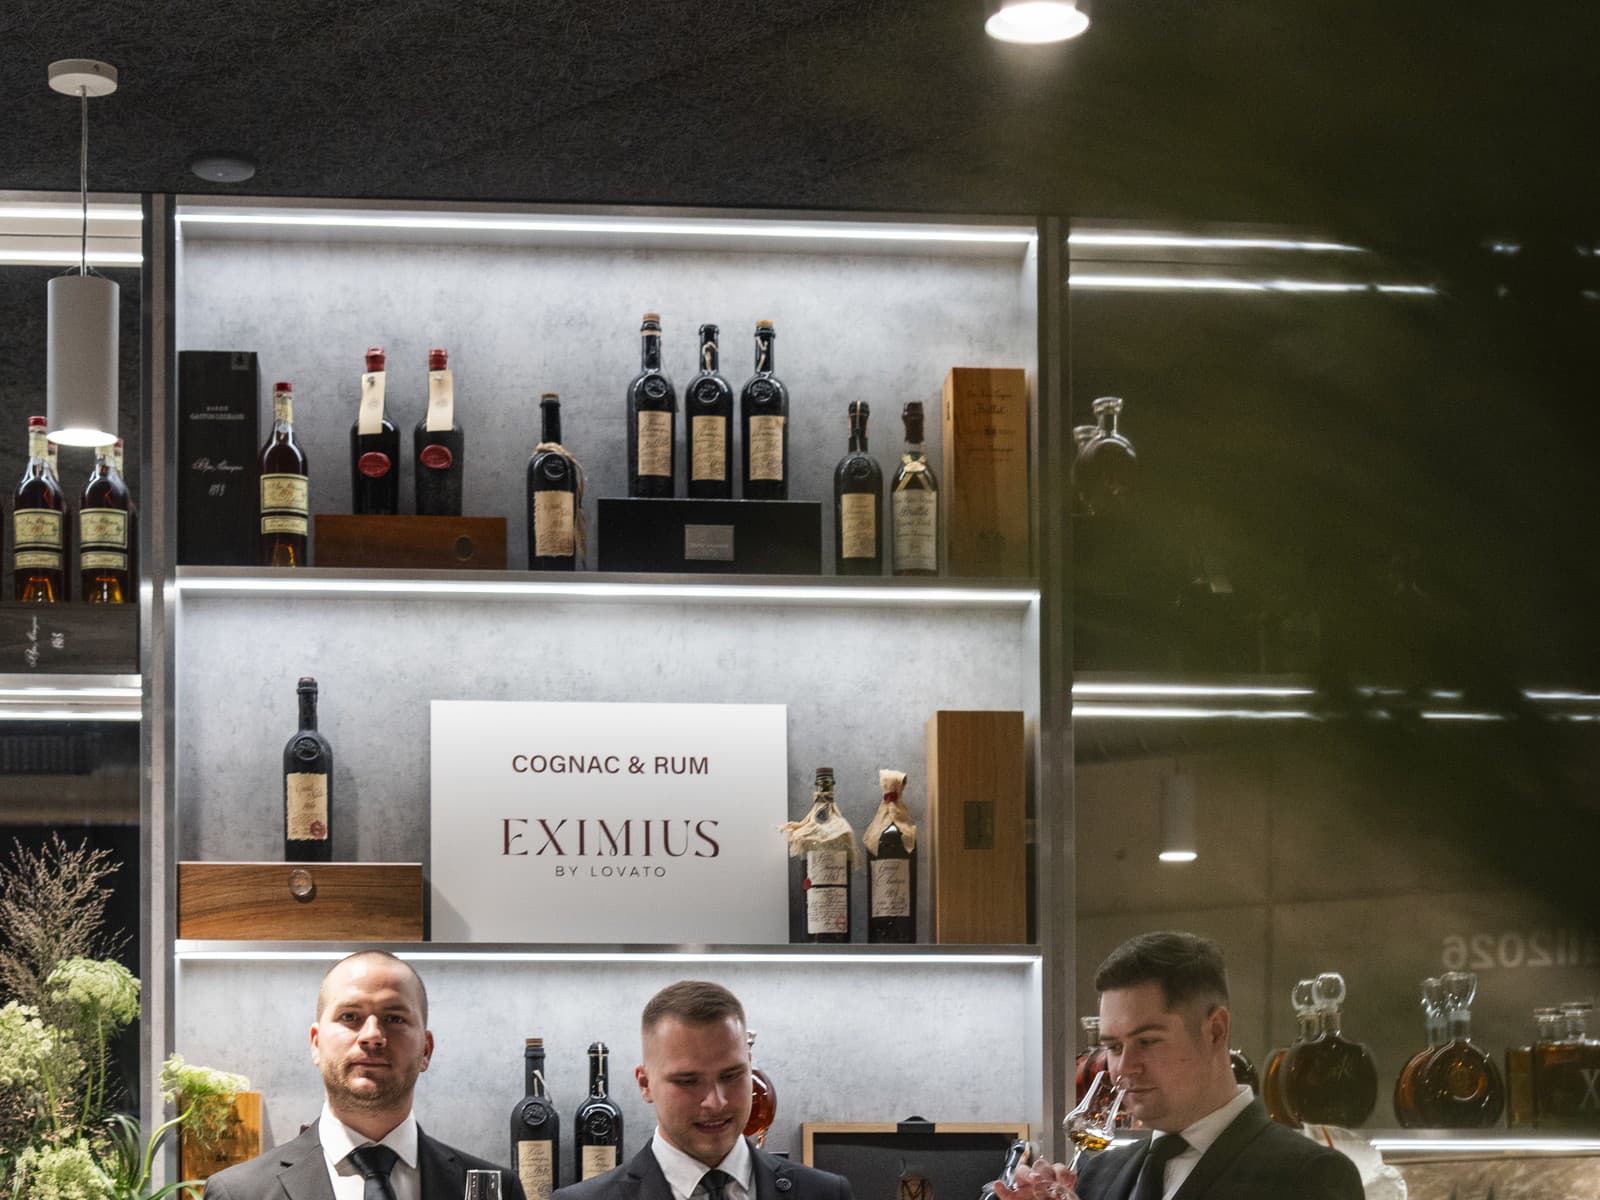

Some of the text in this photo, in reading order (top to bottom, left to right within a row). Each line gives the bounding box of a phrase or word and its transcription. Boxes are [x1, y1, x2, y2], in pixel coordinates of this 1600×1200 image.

[511, 754, 709, 775] COGNAC & RUM
[501, 818, 720, 858] EXIMIUS
[554, 865, 667, 879] BY LOVATO
